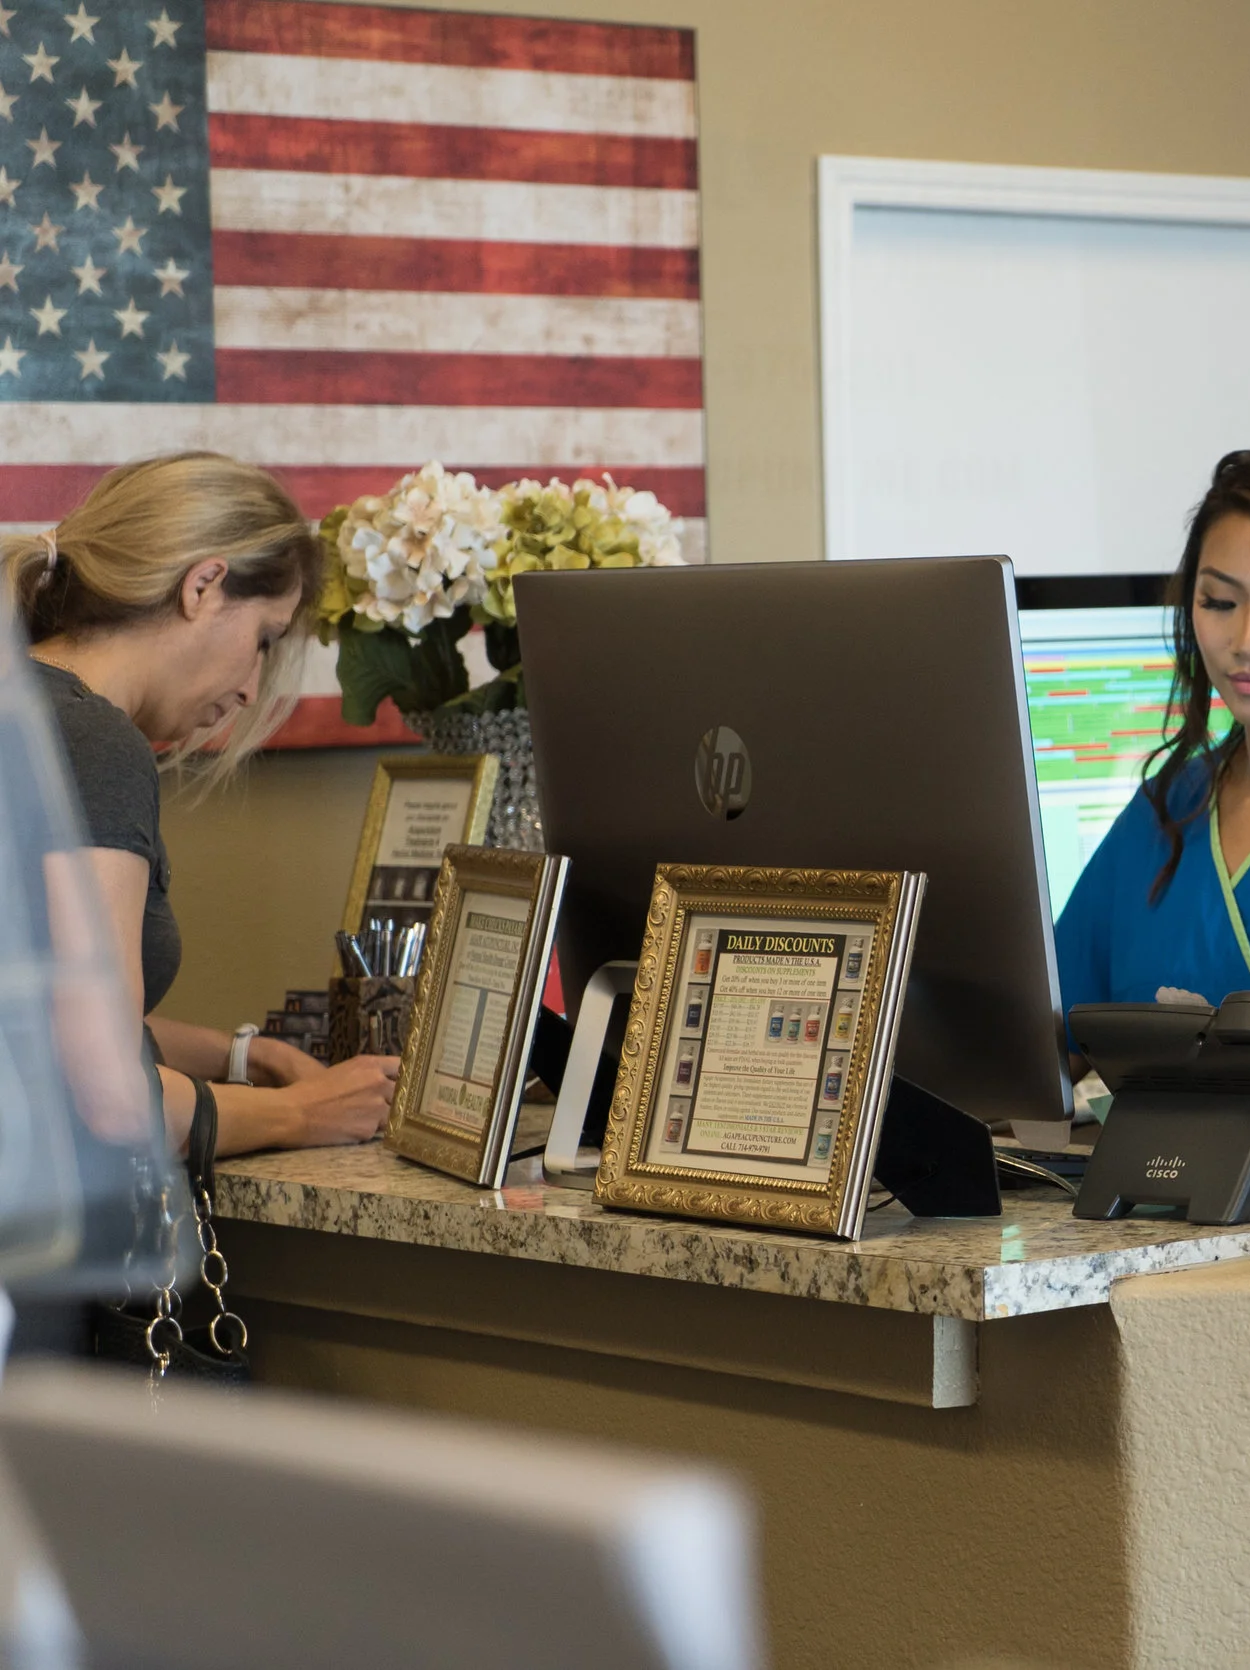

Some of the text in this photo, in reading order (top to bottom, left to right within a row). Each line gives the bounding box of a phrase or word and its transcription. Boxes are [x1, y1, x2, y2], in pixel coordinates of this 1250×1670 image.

[727, 935, 835, 953] DAILY DISCOUNTS
[733, 955, 764, 965] PRODUCTS
[764, 956, 783, 966] MADE
[791, 957, 804, 968] THE
[736, 966, 766, 975] DISCOUNTS
[776, 968, 816, 977] SUPPLEMENTS
[769, 977, 779, 985] buy
[723, 1064, 742, 1072] Improve
[750, 1065, 767, 1074] Quality
[723, 1132, 797, 1145] AGAPEACUPUNCTURE.COM
[720, 1142, 737, 1151] CALL
